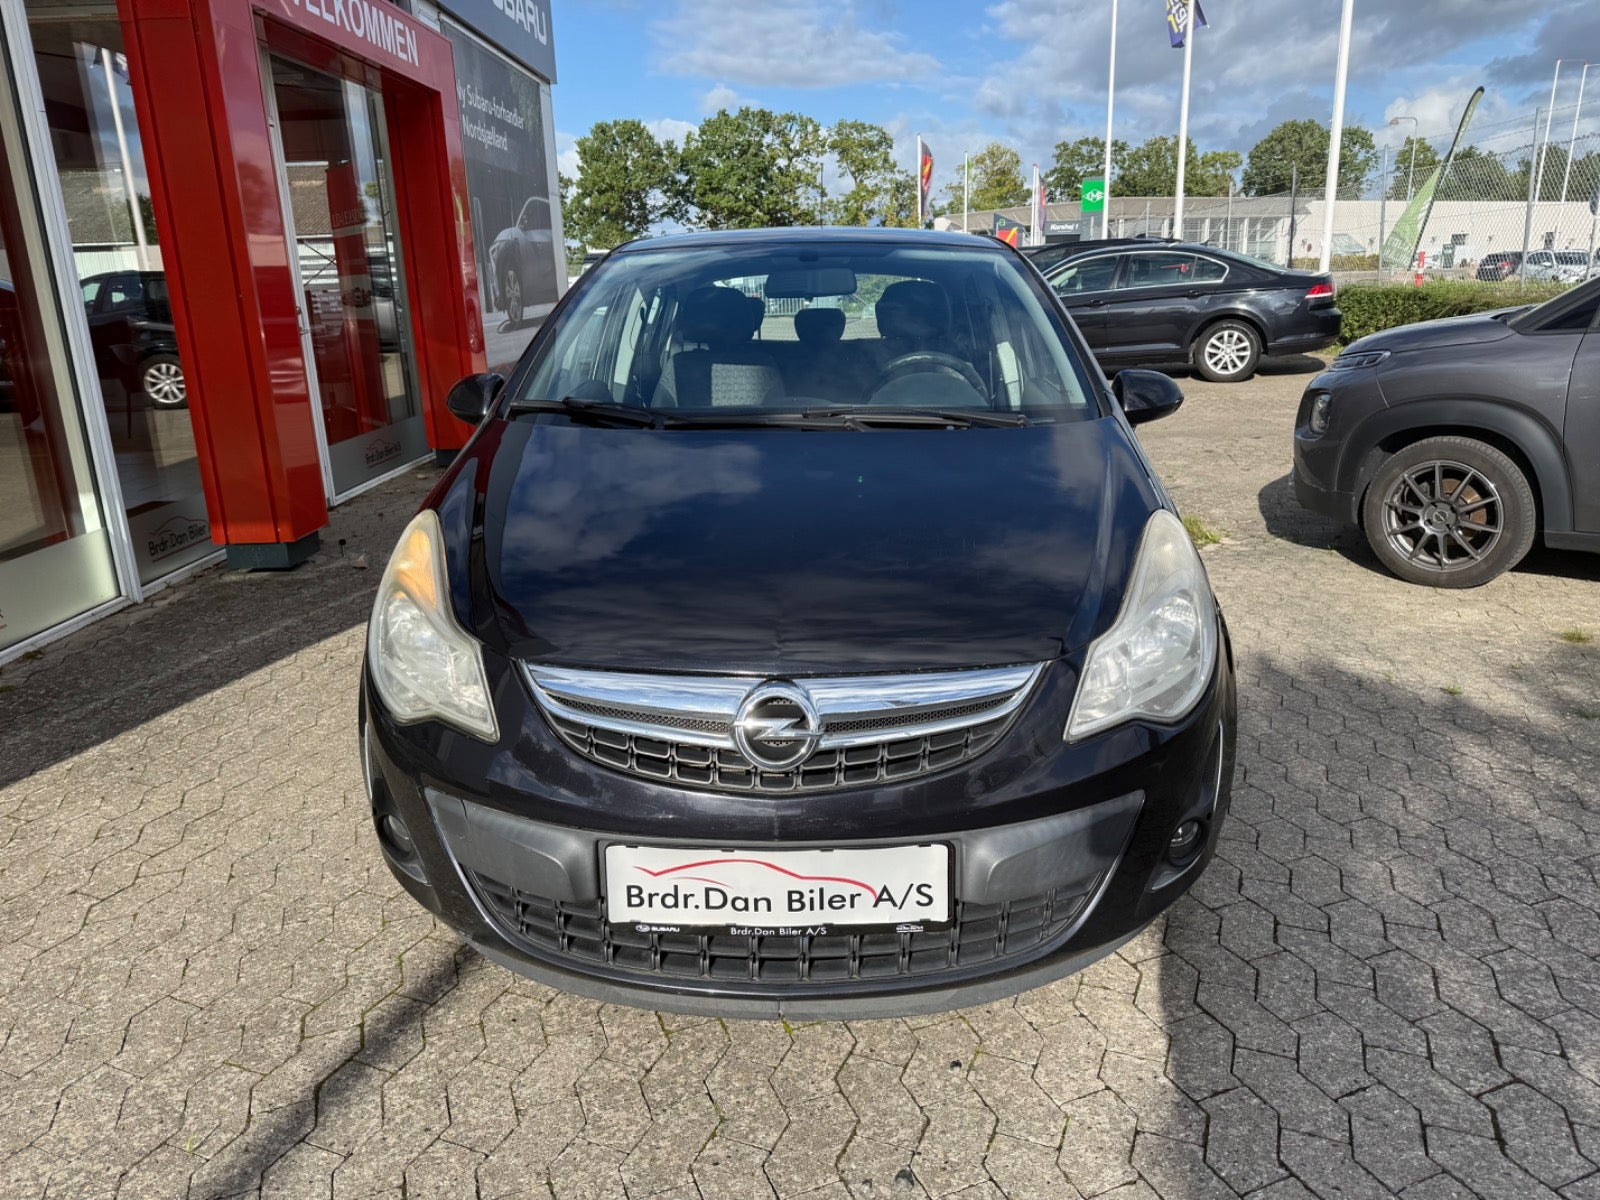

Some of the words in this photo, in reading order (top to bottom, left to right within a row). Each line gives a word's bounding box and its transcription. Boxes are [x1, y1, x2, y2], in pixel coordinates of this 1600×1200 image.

[294, 0, 419, 67] LKOMMEN
[787, 887, 862, 912] Biler
[872, 883, 934, 910] A/S
[779, 927, 802, 936] Biler
[805, 926, 827, 936] A/S
